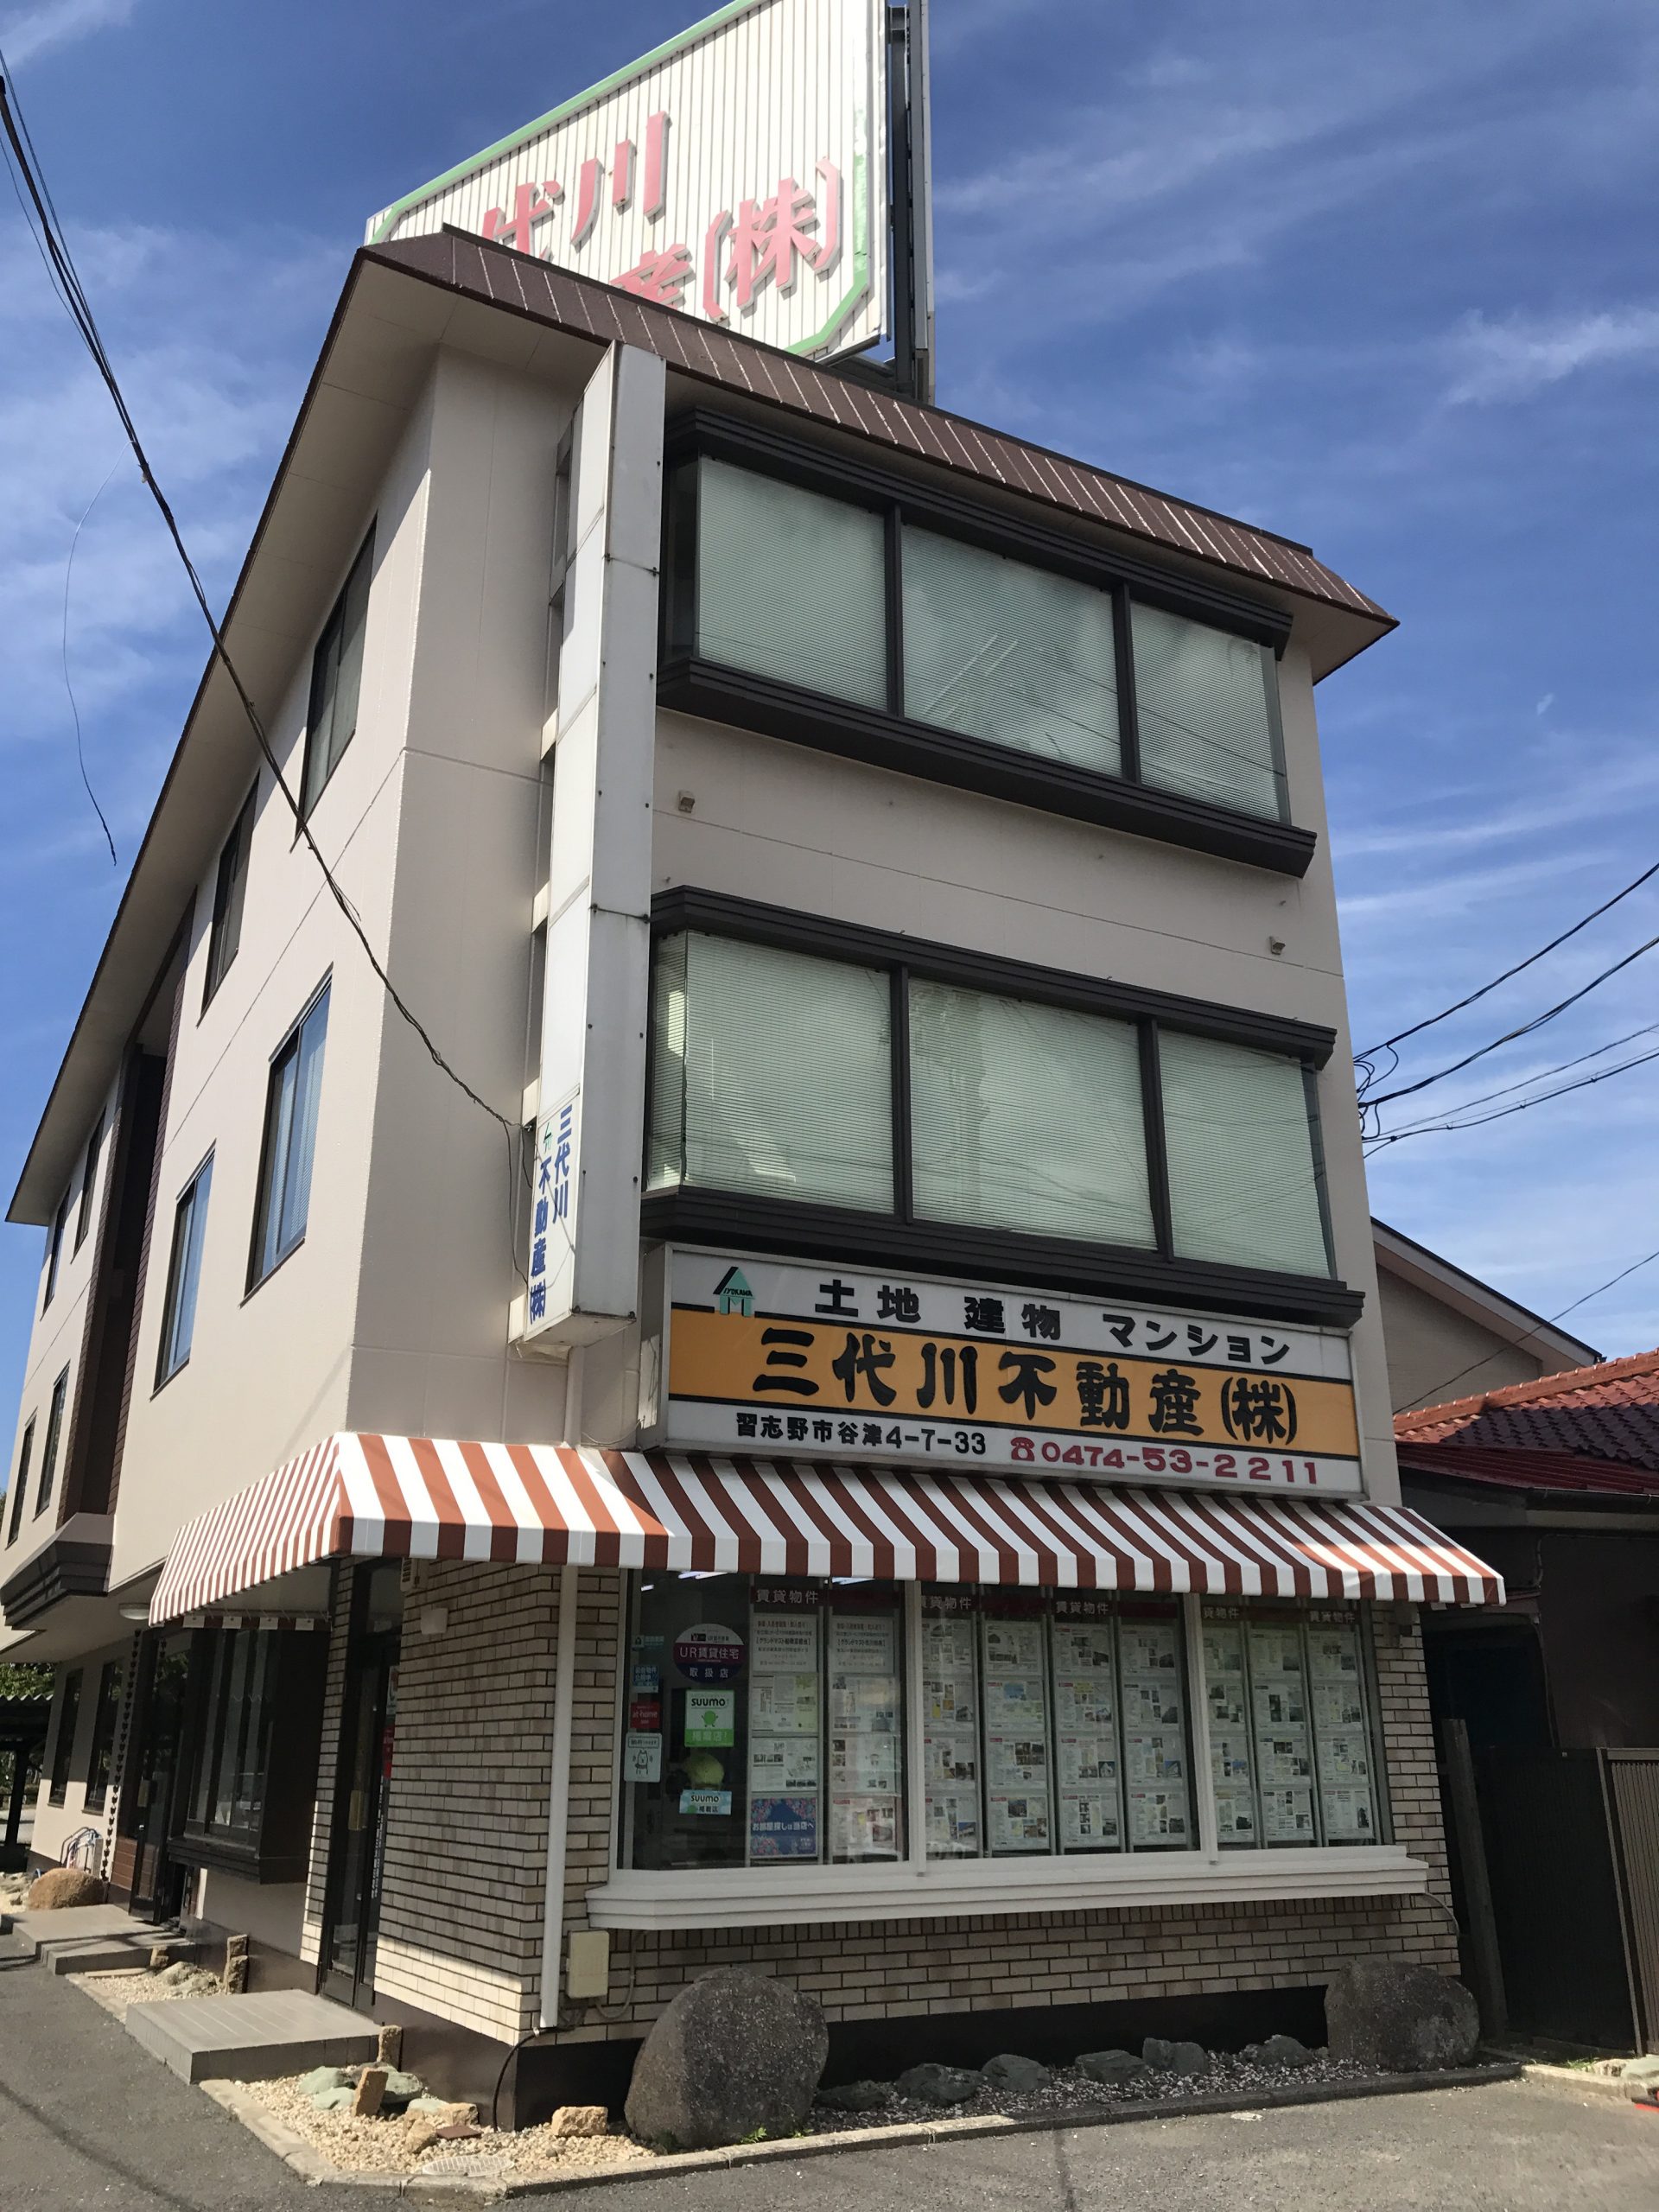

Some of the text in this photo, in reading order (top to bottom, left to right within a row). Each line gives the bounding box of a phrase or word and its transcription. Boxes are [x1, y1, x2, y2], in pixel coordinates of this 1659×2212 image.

[553, 1104, 572, 1224] 三代川
[815, 1279, 1290, 1364] 土地 建物 マンション
[753, 1326, 1298, 1446] 三代川不動産(株)
[736, 1412, 986, 1455] 習志野市谷津4-7-33
[1041, 1441, 1318, 1484] 0474-53-2211
